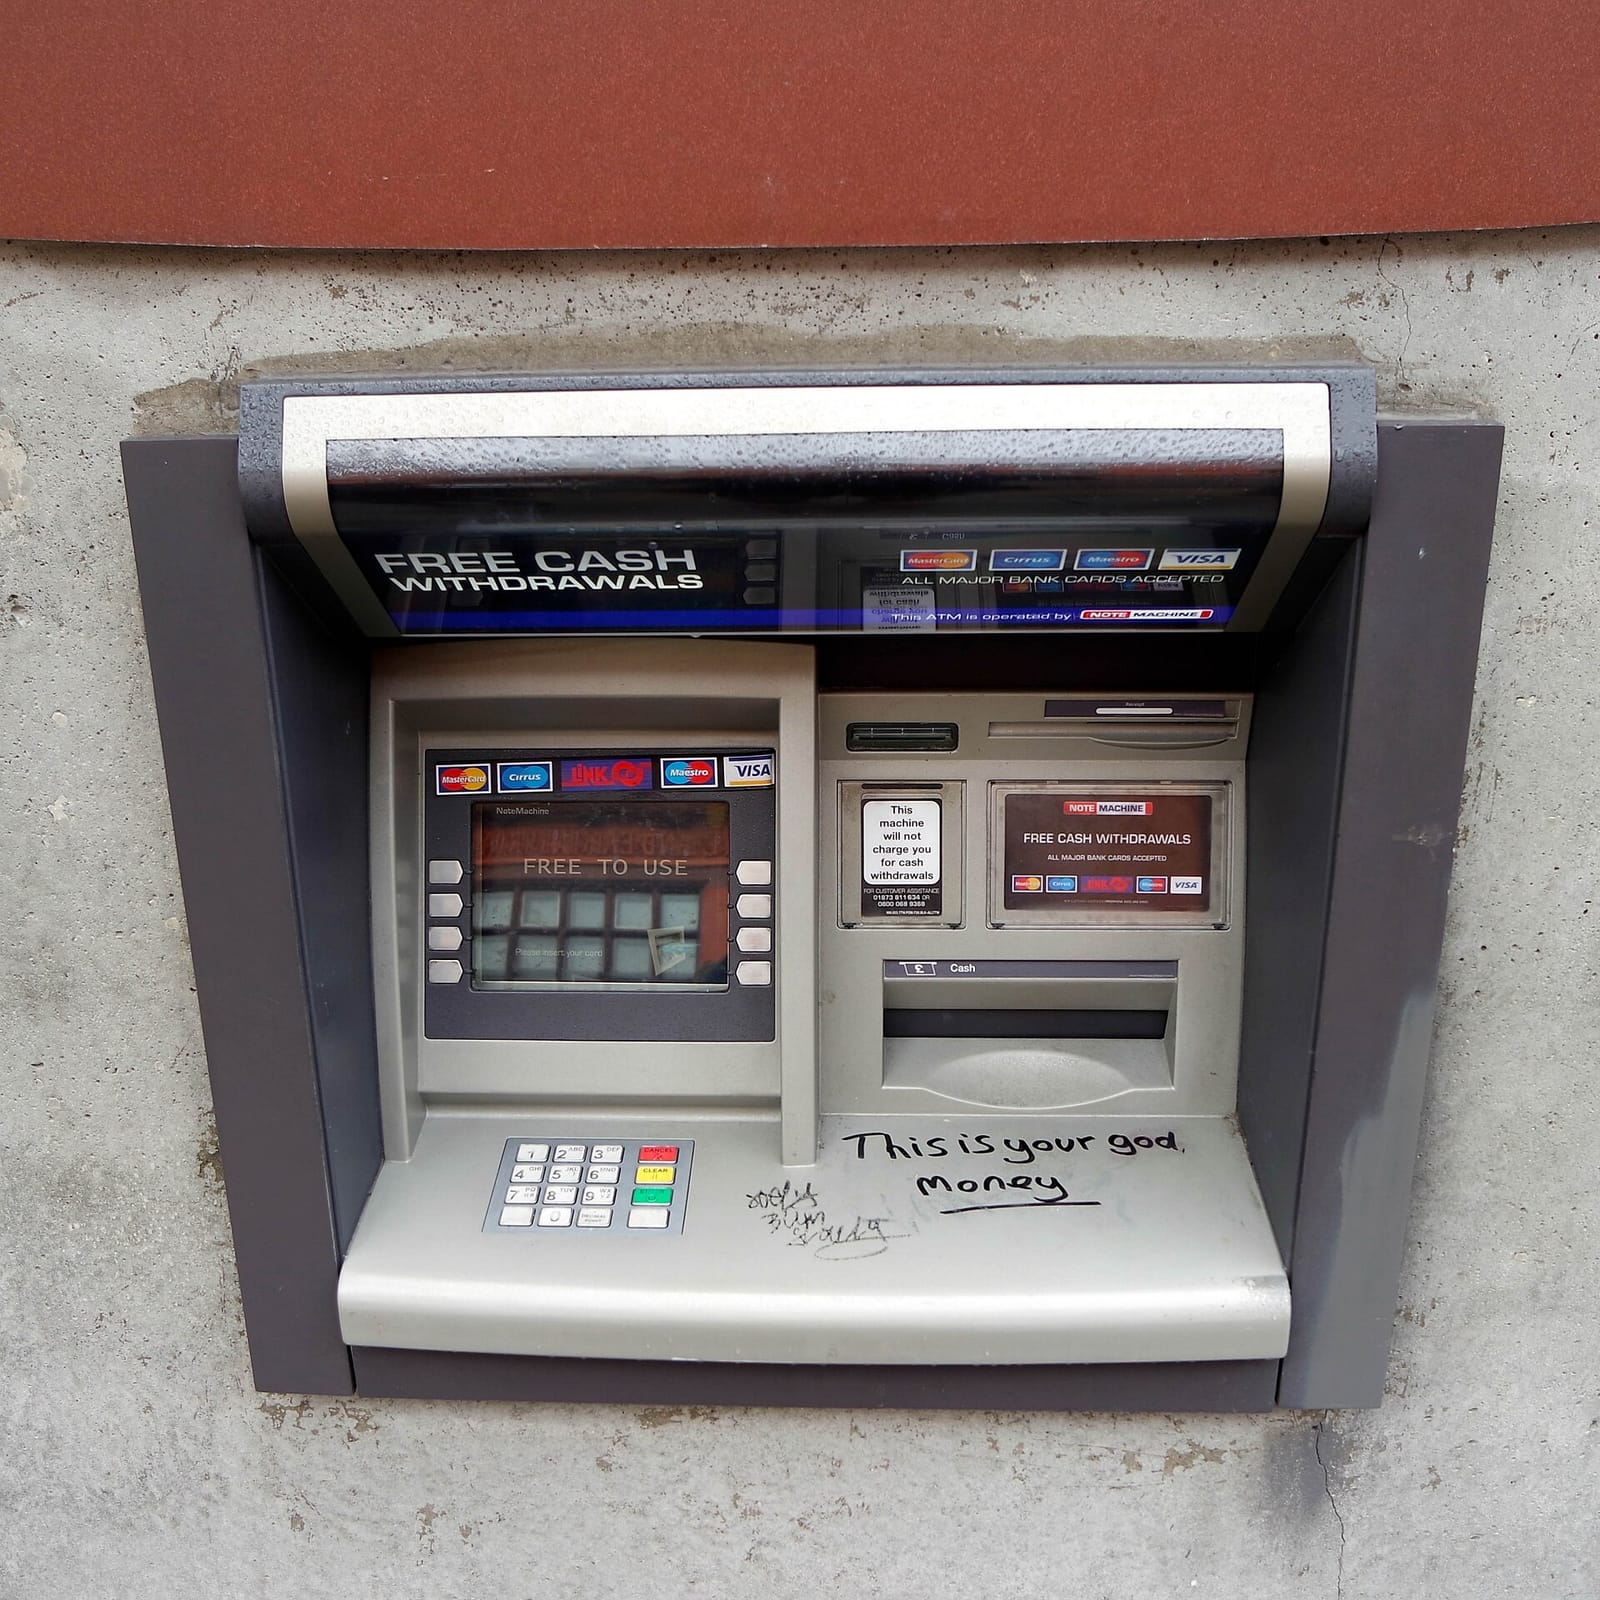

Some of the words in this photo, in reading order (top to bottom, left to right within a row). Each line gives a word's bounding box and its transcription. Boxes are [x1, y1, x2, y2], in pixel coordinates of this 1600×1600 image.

[374, 551, 520, 573] FREE
[535, 550, 697, 572] CASH
[907, 556, 970, 565] MasterCard
[1004, 556, 1050, 564] Cirrus
[1176, 554, 1225, 564] VISA
[389, 574, 703, 592] WITHDRAWALS
[901, 576, 934, 585] ALL
[939, 576, 1004, 585] MAJOR
[1009, 575, 1060, 584] BANK
[1064, 575, 1127, 584] CARDS
[1131, 575, 1225, 583] ACCEPTED
[891, 613, 922, 621] This
[926, 613, 962, 621] ATM
[982, 612, 1053, 622] operated
[1054, 613, 1072, 621] by
[1089, 611, 1128, 619] NOTE
[571, 763, 609, 784] LINK
[670, 768, 709, 777] Maestro
[735, 763, 771, 777] VISA
[441, 775, 486, 784] MasterCard
[508, 773, 541, 781] Cirrus
[496, 807, 550, 815] NoteMachine
[890, 805, 913, 815] This
[1069, 803, 1095, 813] NOTE
[1099, 803, 1144, 813] MACHINE
[879, 819, 925, 828] machine
[883, 832, 901, 841] will
[903, 832, 921, 841] not
[1023, 832, 1054, 844] FREE
[1057, 833, 1092, 844] CASH
[1096, 833, 1192, 845] WITHDRAWALS
[872, 845, 909, 855] charge
[911, 846, 932, 855] you
[881, 858, 896, 867] for
[898, 858, 924, 867] cash
[1061, 854, 1086, 862] MAJOR
[1087, 854, 1106, 862] BANK
[1107, 854, 1131, 862] CARDS
[1132, 854, 1167, 862] ACCEPTED
[523, 858, 582, 875] FREE
[597, 858, 628, 875] TO
[643, 859, 689, 876] USE
[870, 871, 934, 880] withdrawals
[1175, 881, 1198, 889] VISA
[950, 963, 976, 973] Cash
[842, 1132, 950, 1159] This
[958, 1133, 995, 1154] is
[1003, 1135, 1096, 1164] your
[528, 1150, 534, 1159] 1
[557, 1149, 567, 1159] 2
[594, 1149, 604, 1159] 3
[514, 1169, 524, 1179] 4
[551, 1169, 561, 1180] 5
[590, 1170, 599, 1180] 6
[509, 1189, 519, 1200] 7
[546, 1190, 557, 1200] 8
[585, 1191, 595, 1201] 9
